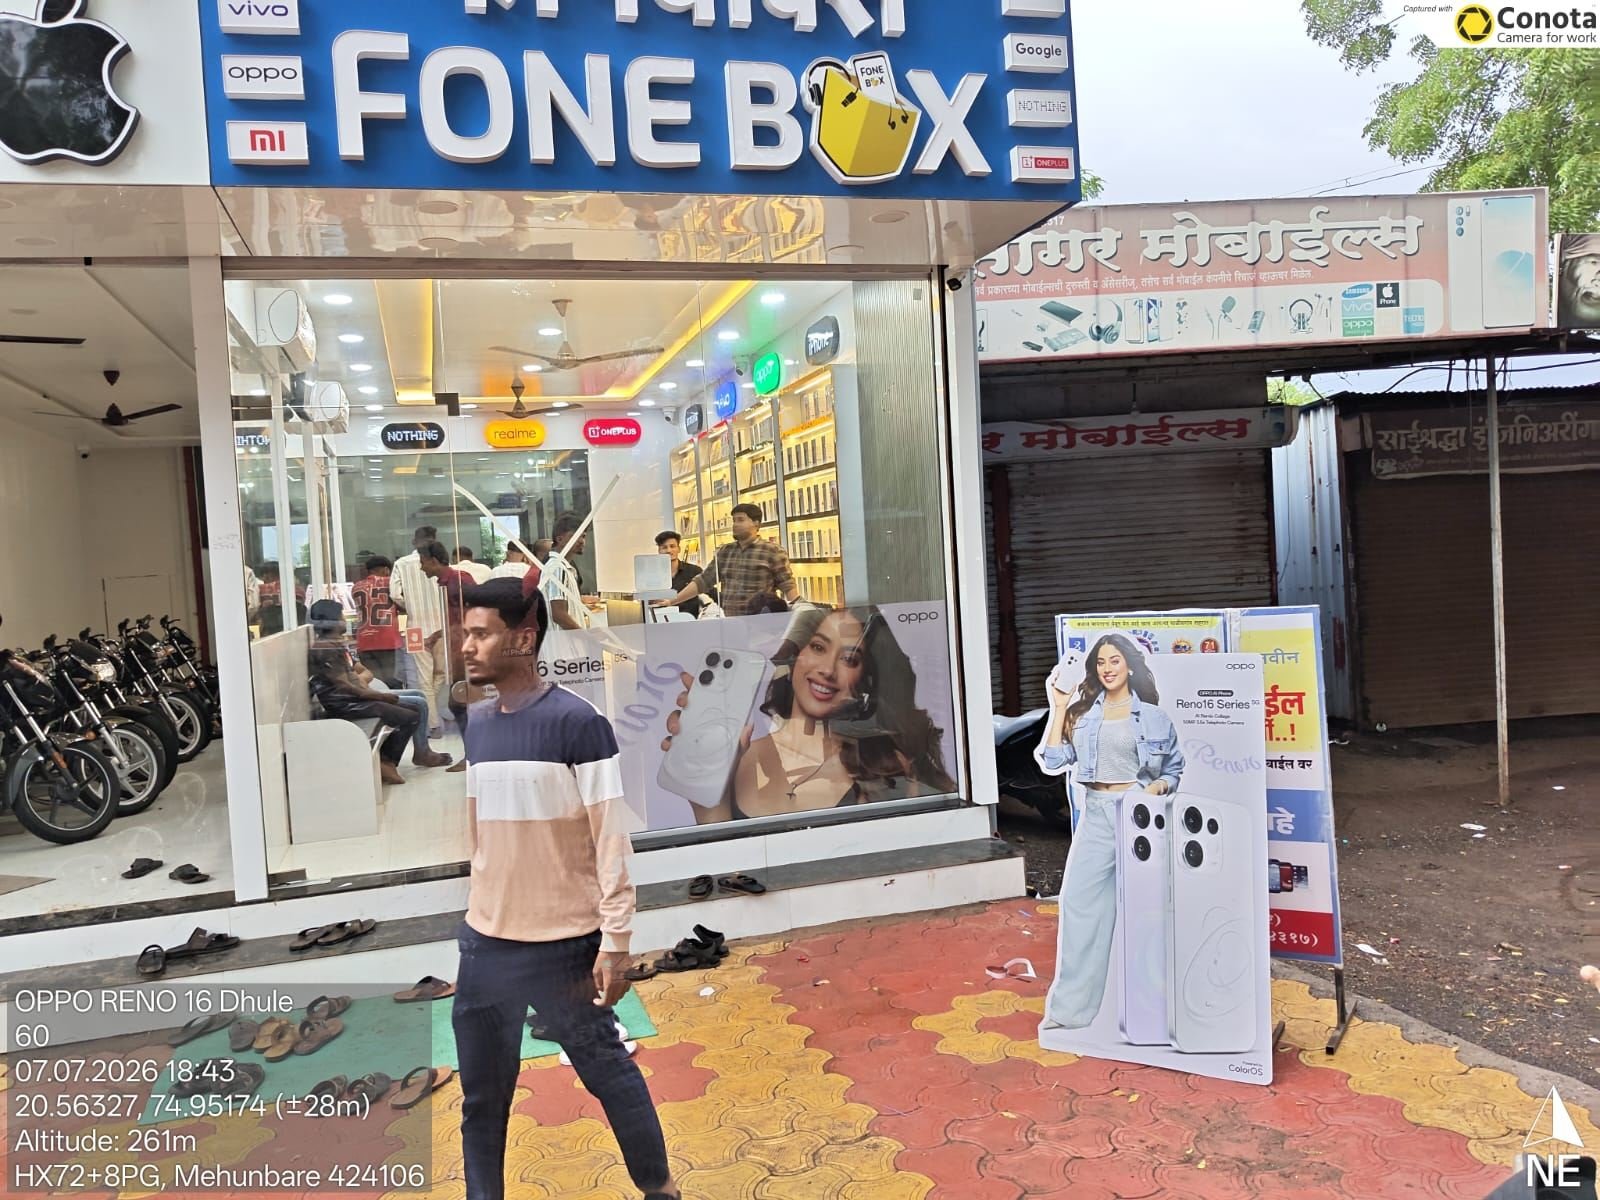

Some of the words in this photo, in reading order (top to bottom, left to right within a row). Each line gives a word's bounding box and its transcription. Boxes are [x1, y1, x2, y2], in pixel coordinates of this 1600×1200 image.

[228, 0, 289, 17] vivo
[1016, 42, 1062, 59] Google
[228, 65, 298, 83] oppo
[860, 66, 885, 77] FONE
[865, 77, 885, 87] BX
[332, 29, 701, 169] FONE
[724, 52, 993, 185] BX
[1018, 101, 1067, 112] NOTHING
[1140, 206, 1425, 268] मोबाईल्स
[387, 429, 439, 441] NOTHING
[494, 428, 537, 440] realme
[601, 427, 637, 436] ONEPLUS
[1020, 415, 1251, 450] मोबाईल्स
[898, 611, 939, 625] oppo
[553, 656, 611, 676] Series
[1225, 663, 1256, 671] oppo
[1176, 699, 1215, 709] Reno16
[1216, 699, 1250, 710] Series
[1228, 1064, 1264, 1077] ColorOS
